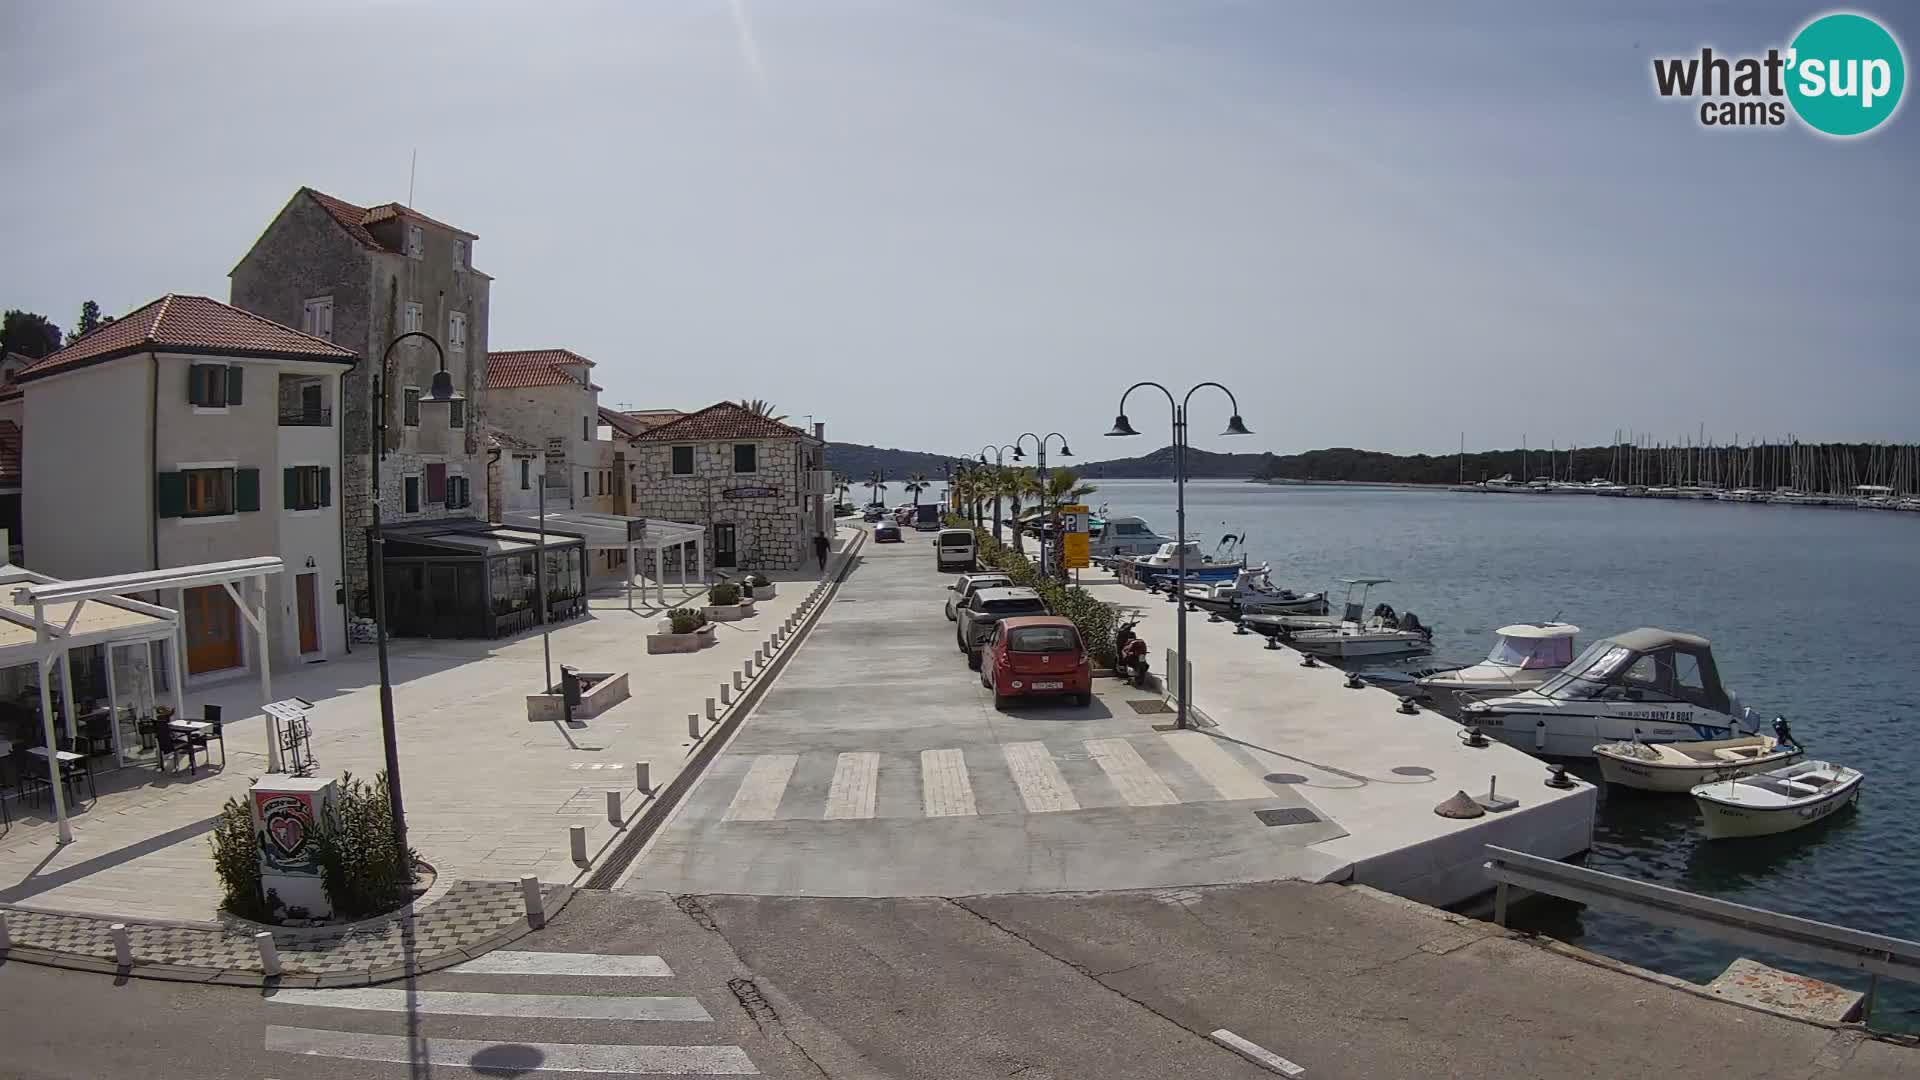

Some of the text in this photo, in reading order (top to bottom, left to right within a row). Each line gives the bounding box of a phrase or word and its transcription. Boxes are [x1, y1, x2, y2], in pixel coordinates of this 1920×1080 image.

[1066, 515, 1076, 529] P
[1651, 711, 1669, 720] RENT
[1676, 711, 1693, 721] BOAT
